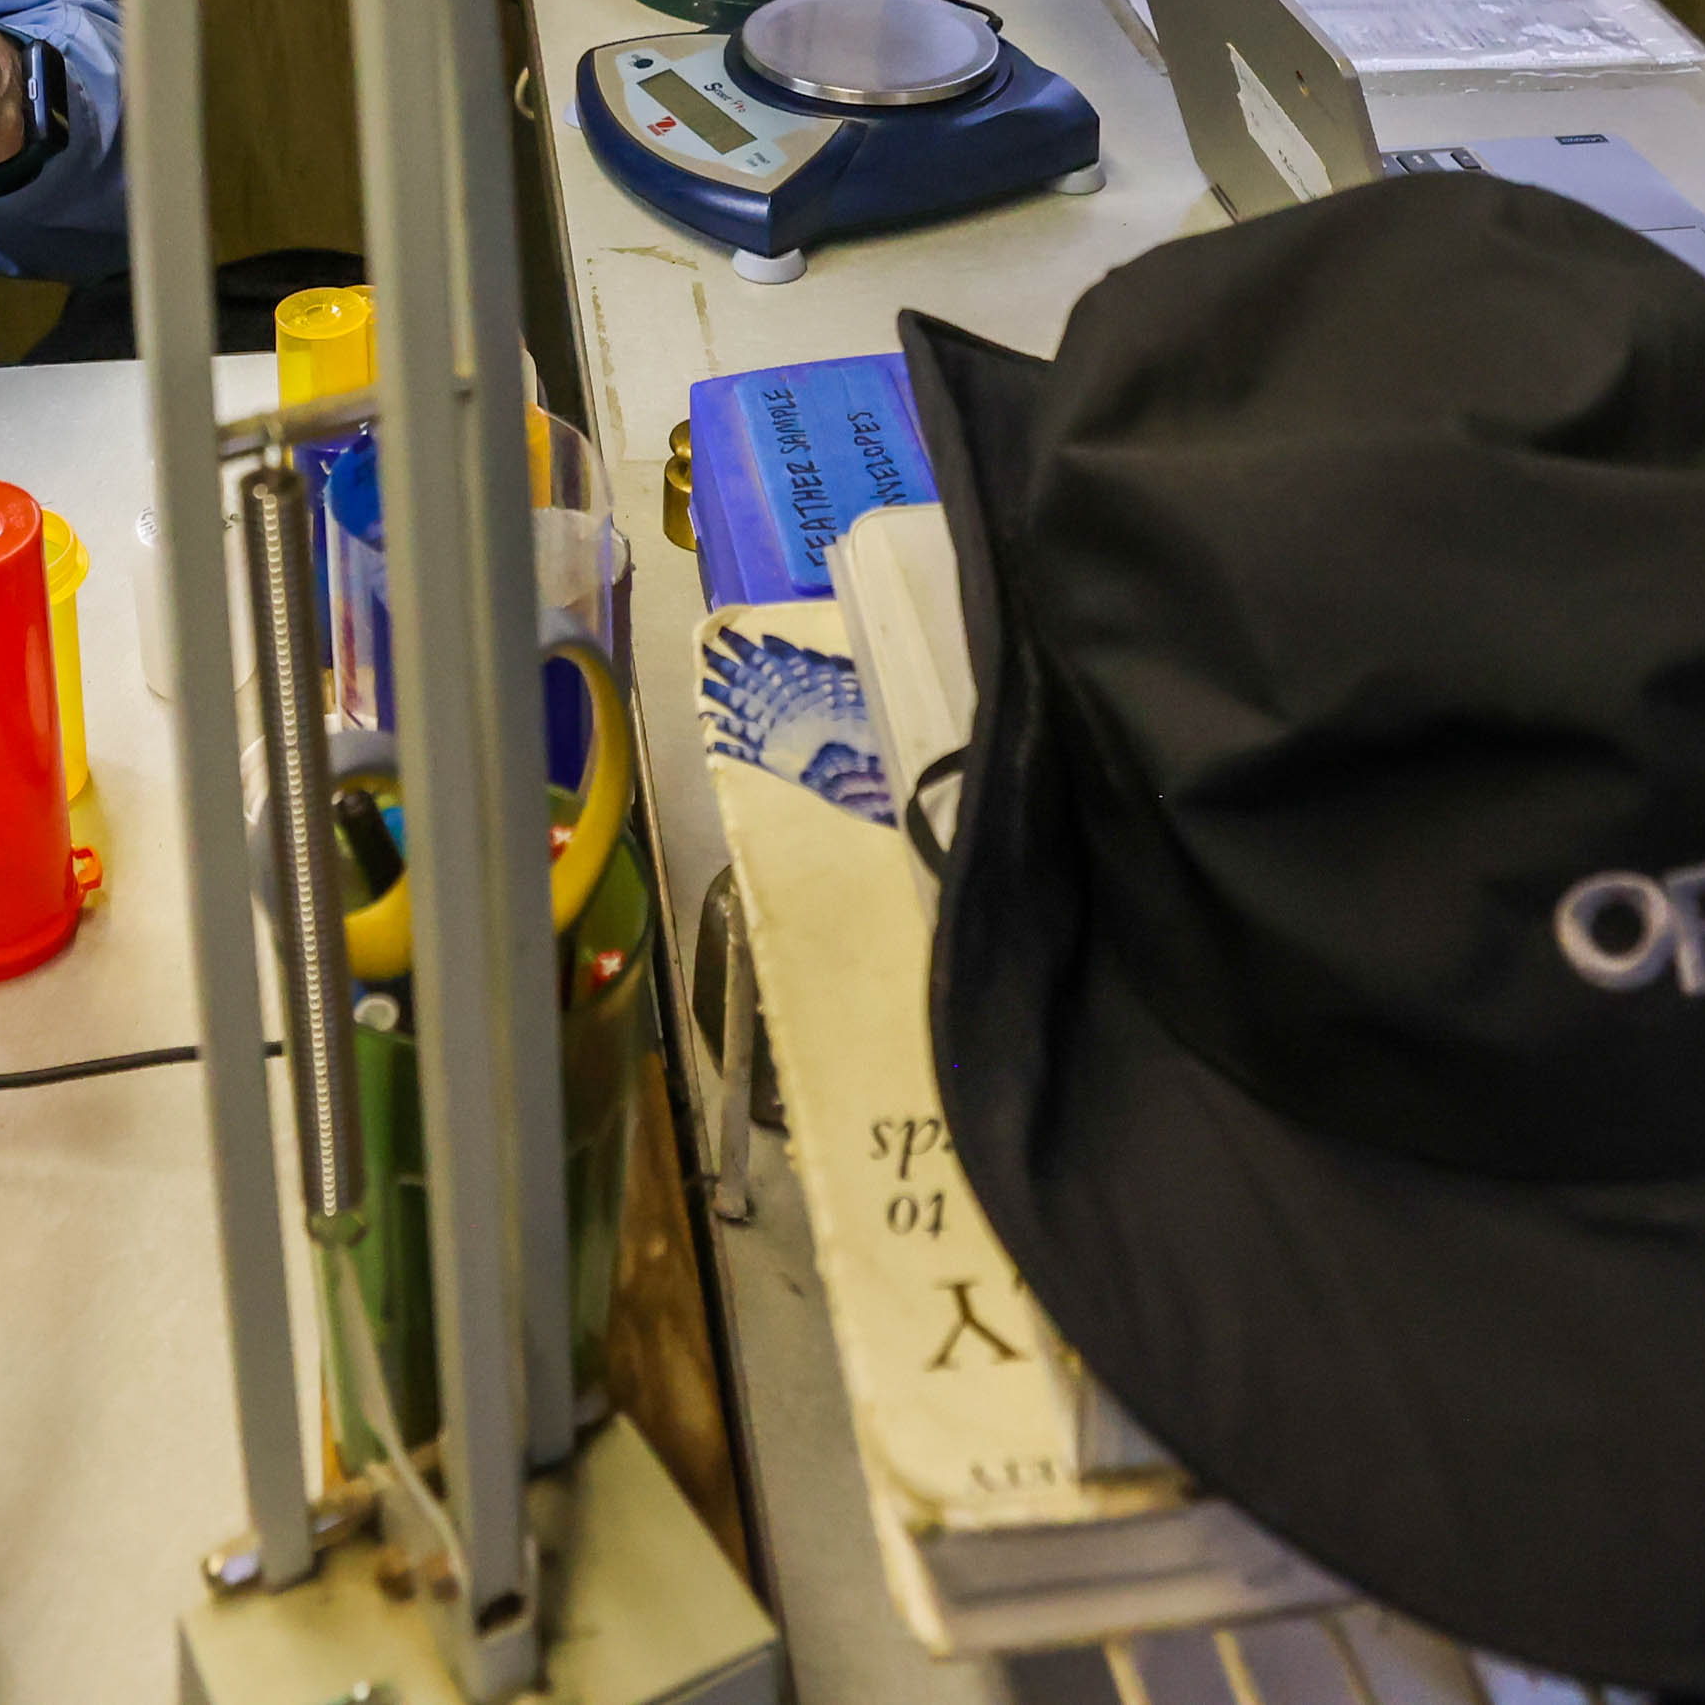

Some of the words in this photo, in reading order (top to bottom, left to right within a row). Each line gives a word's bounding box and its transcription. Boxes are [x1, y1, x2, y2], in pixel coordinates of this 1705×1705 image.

[763, 385, 813, 456] SAMPLE
[791, 458, 837, 569] FEATHER
[869, 1115, 955, 1179] ds
[886, 1189, 948, 1239] to
